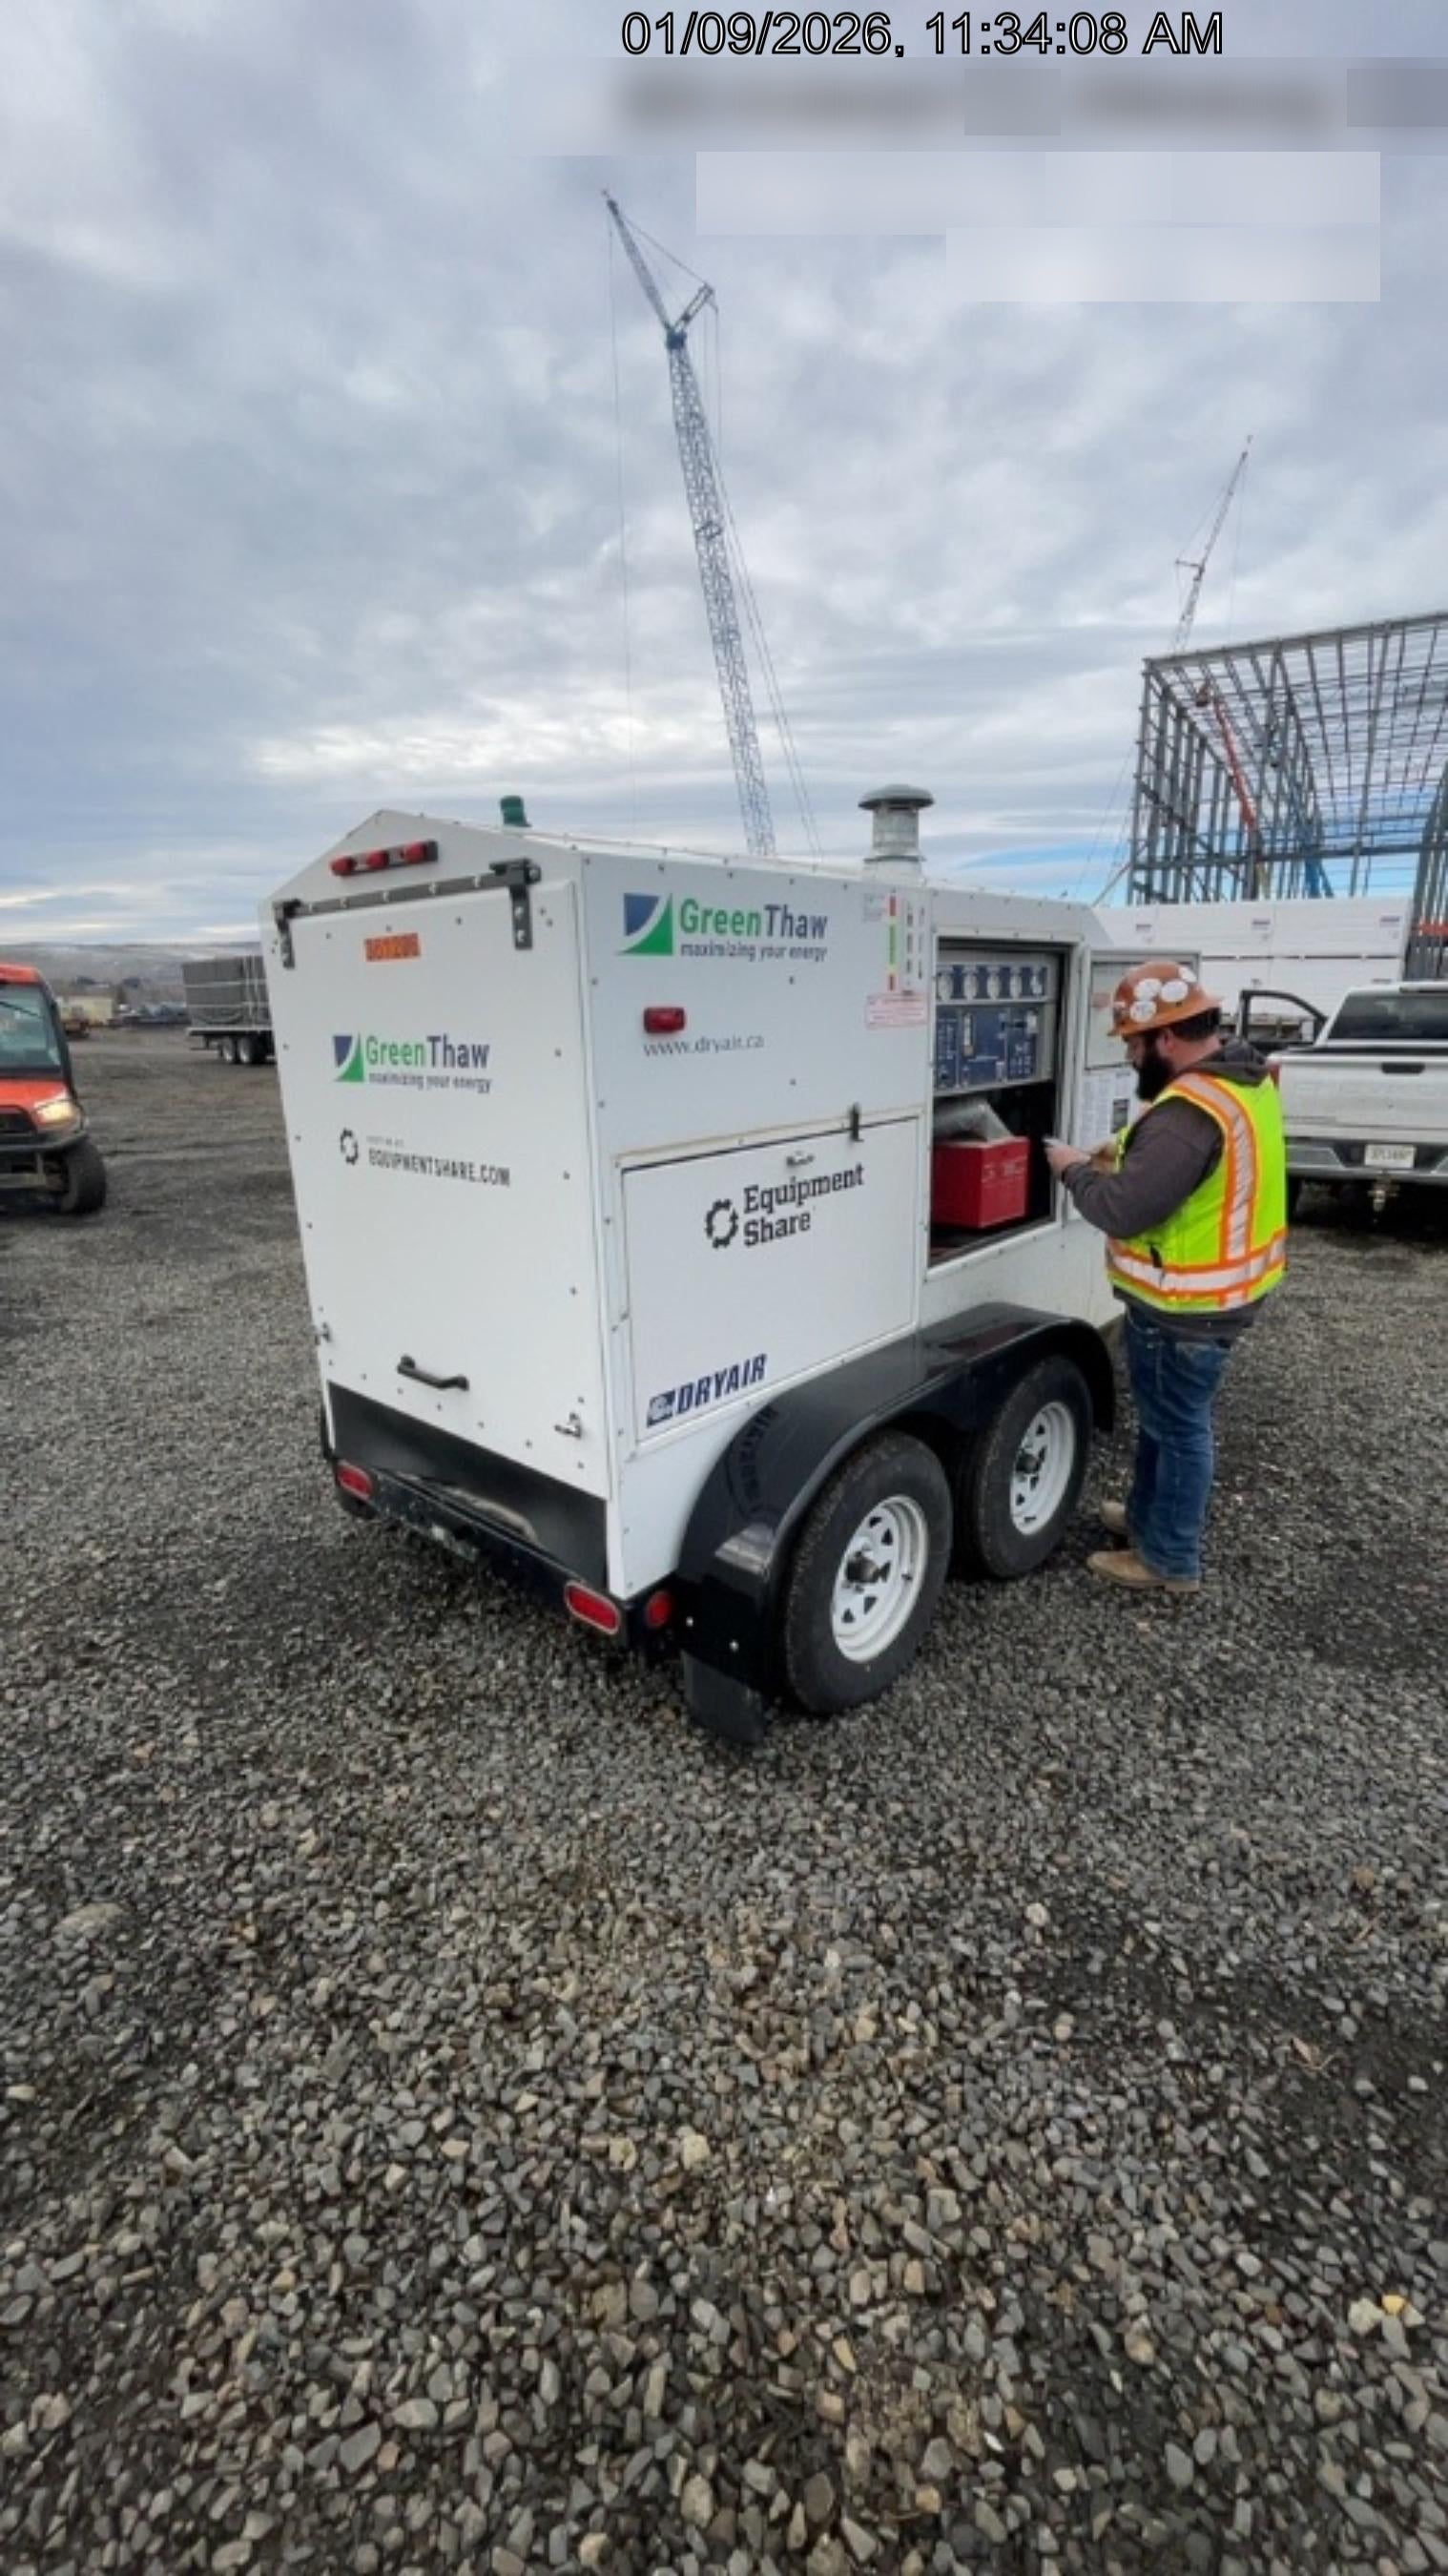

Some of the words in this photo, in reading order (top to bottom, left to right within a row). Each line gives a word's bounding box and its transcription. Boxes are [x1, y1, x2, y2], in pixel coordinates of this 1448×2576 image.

[680, 898, 828, 939] GreenThaw
[681, 942, 756, 962] maximizing
[789, 945, 828, 963] energy
[366, 1033, 490, 1069] GreenThaw
[368, 1148, 510, 1187] EQUIPMENTSHARE.COM
[743, 1162, 864, 1215] Equipment
[744, 1211, 811, 1248] Share
[677, 1353, 767, 1414] DRYAIR
